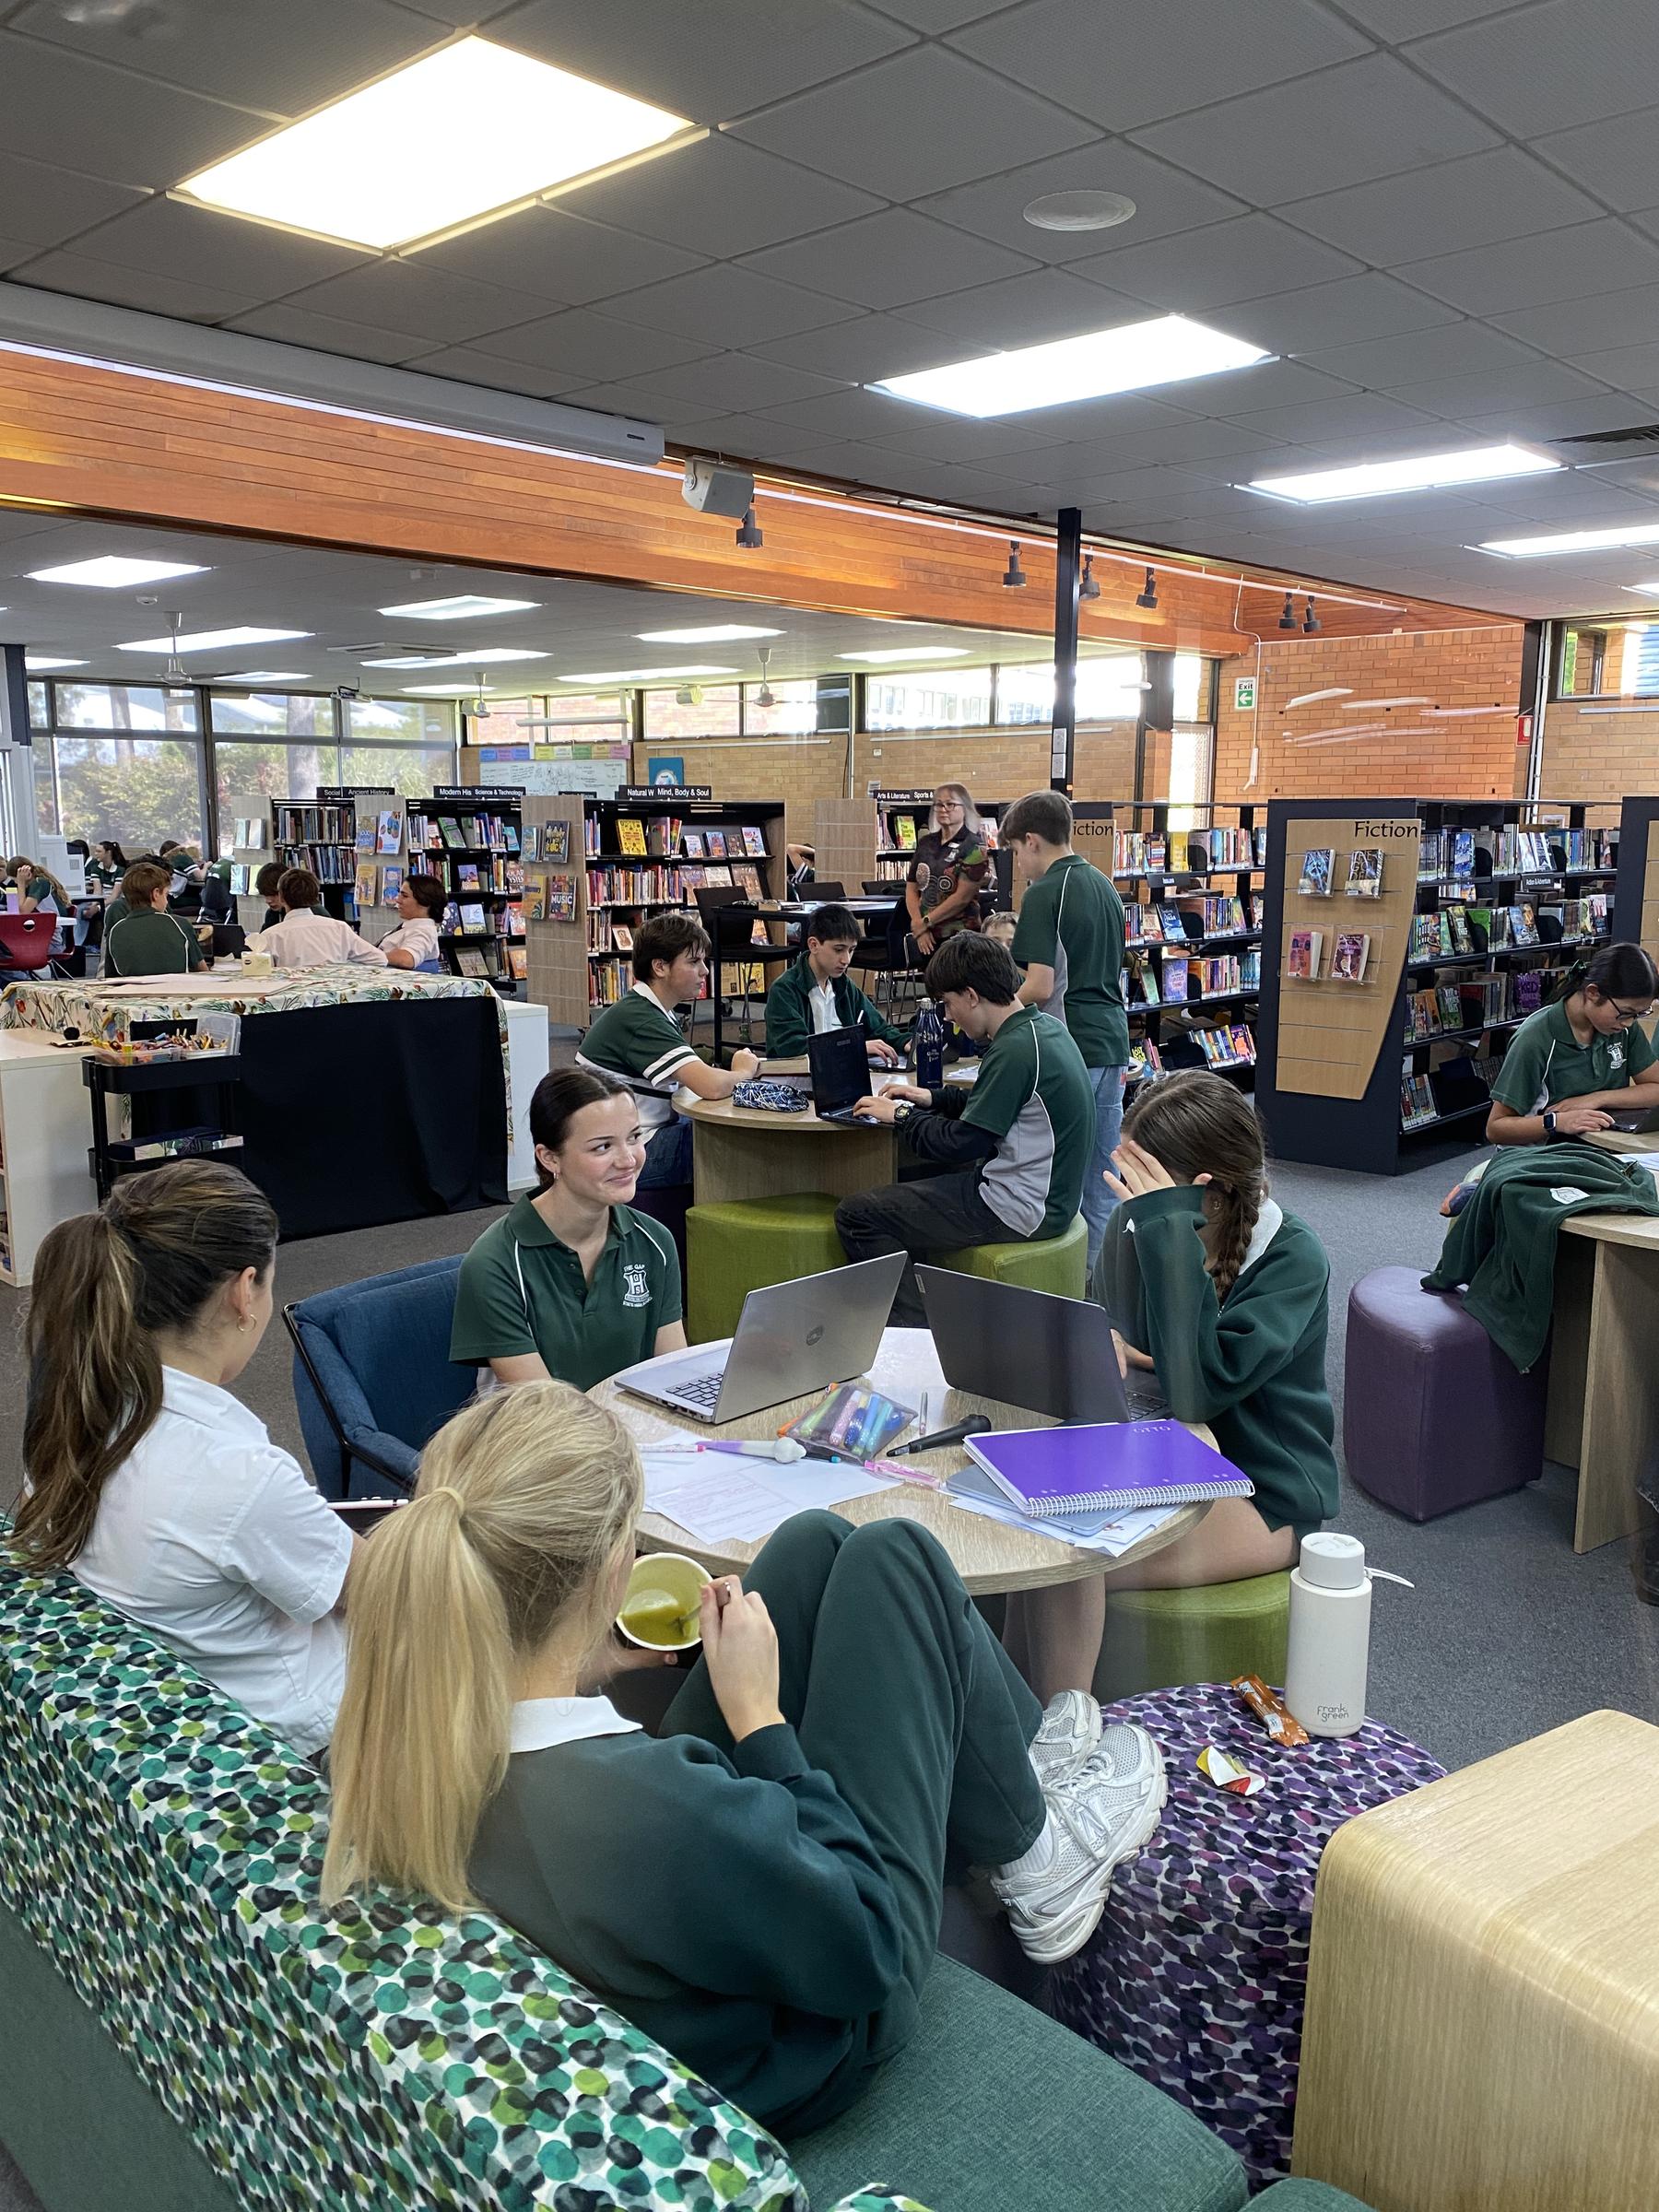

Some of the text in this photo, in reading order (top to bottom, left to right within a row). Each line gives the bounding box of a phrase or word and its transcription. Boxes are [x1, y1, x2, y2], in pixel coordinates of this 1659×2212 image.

[439, 788, 461, 796] Modern
[499, 789, 524, 797] Technology
[628, 788, 648, 796] Natural
[657, 788, 710, 798] Mind, Body & Soul
[1073, 820, 1113, 837] iction
[1354, 820, 1418, 838] Fiction
[551, 894, 573, 904] MUSIC
[1317, 1703, 1348, 1715] frank
[1321, 1712, 1349, 1723] green
